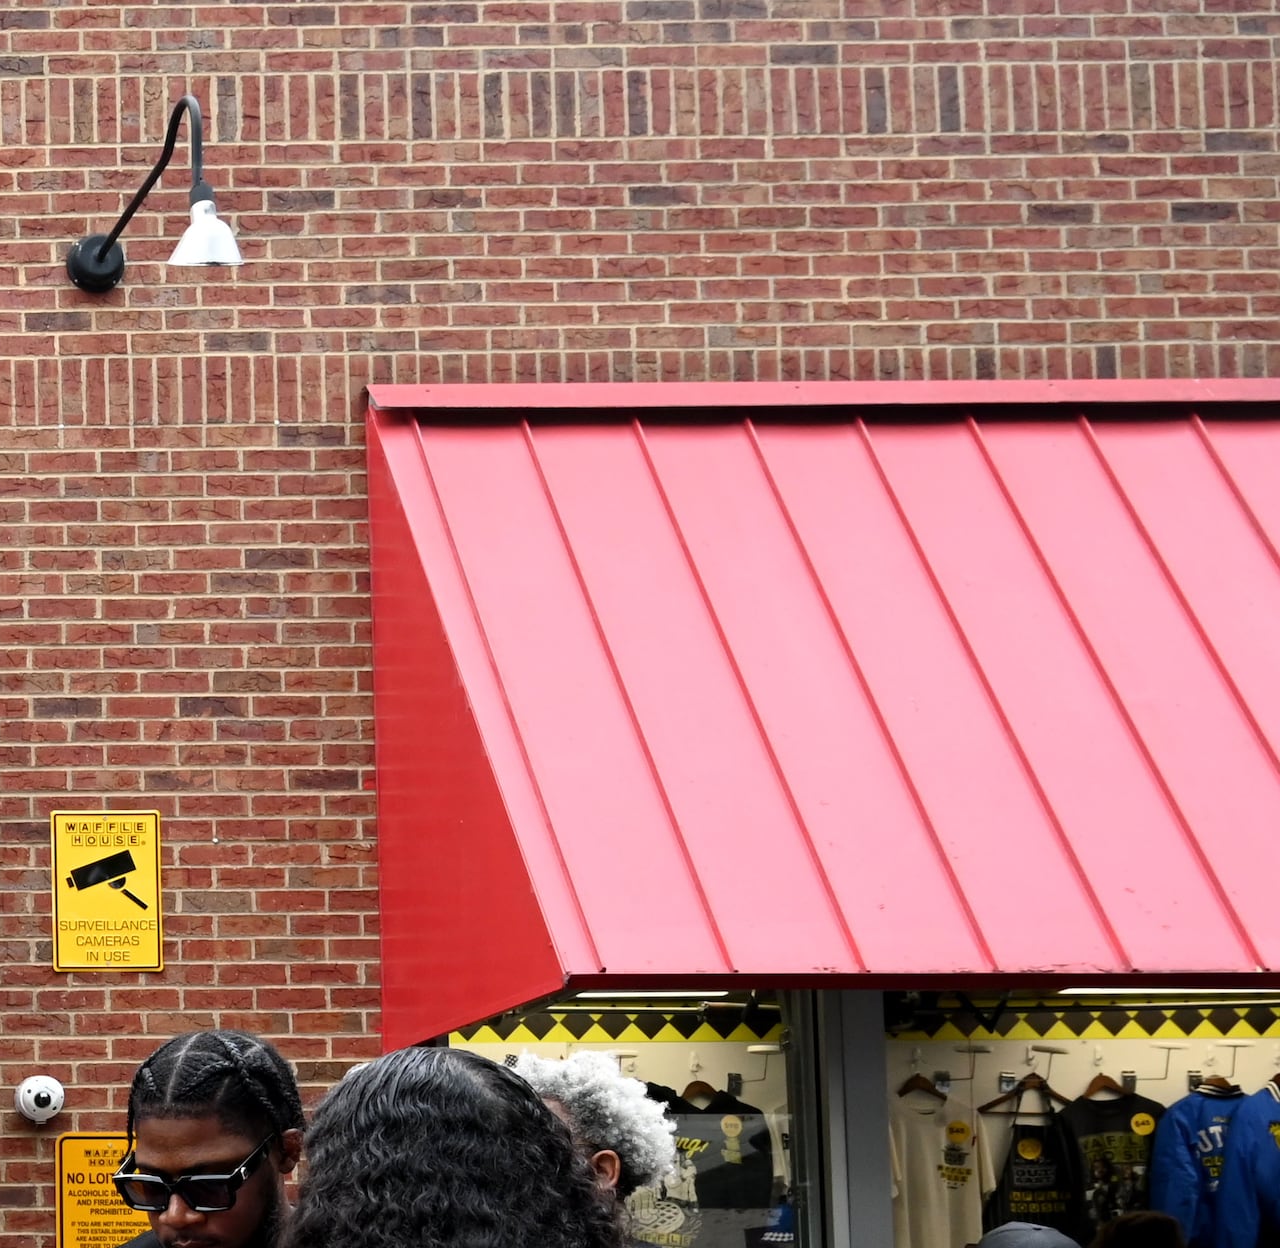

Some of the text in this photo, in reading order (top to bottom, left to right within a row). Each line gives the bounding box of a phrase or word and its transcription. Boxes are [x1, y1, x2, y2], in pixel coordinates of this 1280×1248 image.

[67, 822, 145, 832] WAFFLE
[73, 834, 139, 845] HOUSE
[59, 920, 156, 931] SURVEILLANCE
[76, 936, 140, 946] CAMERAS
[86, 951, 130, 961] IN USE
[67, 1172, 85, 1184] NO
